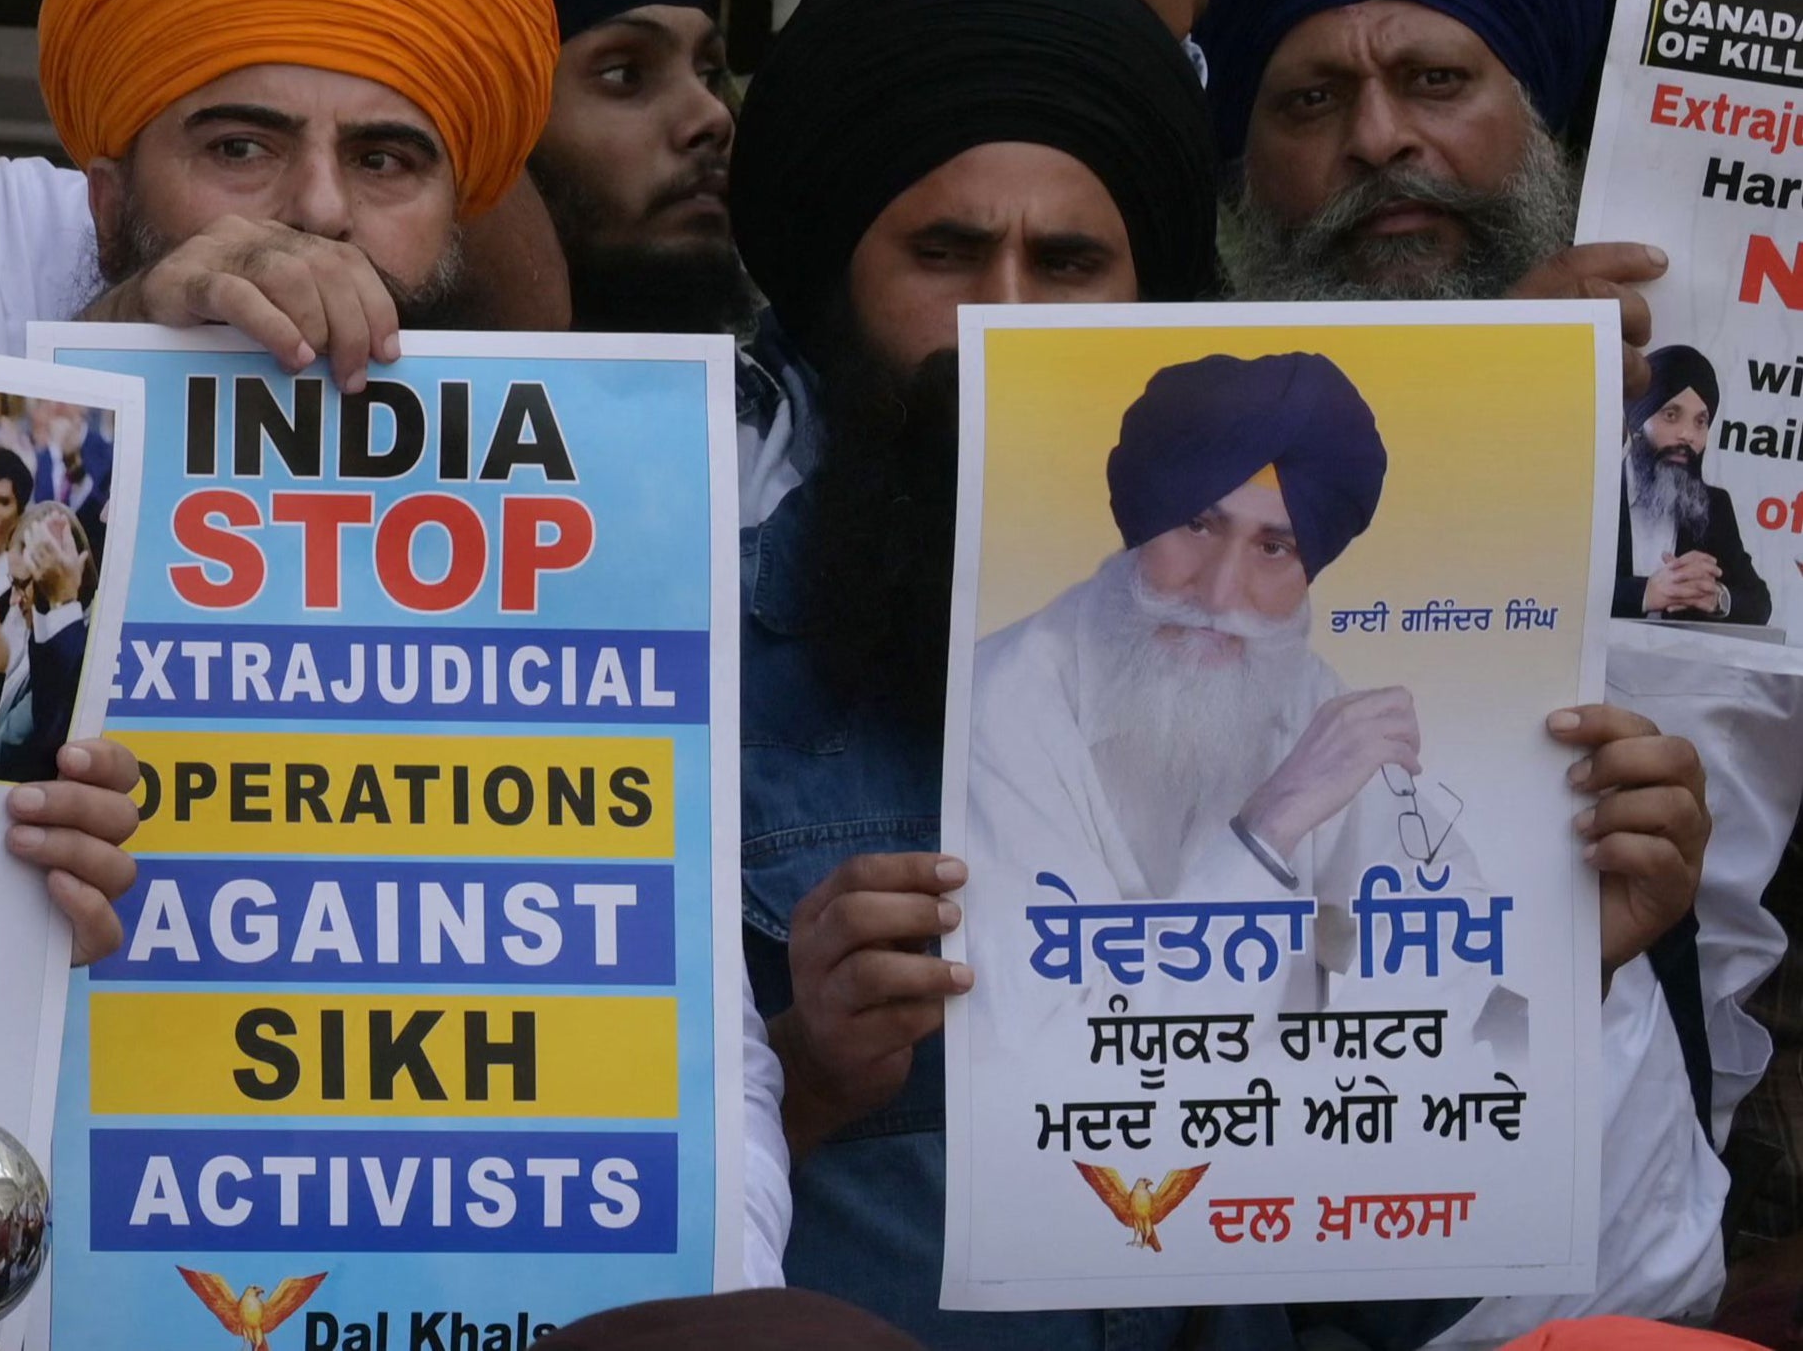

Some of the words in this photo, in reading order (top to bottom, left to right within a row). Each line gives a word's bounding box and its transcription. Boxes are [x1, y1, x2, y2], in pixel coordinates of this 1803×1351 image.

[1657, 31, 1709, 61] OF
[1702, 157, 1803, 209] Har
[185, 376, 578, 483] INDIA
[168, 490, 595, 614] STOP
[1331, 600, 1390, 633] ਭਾਈ
[1402, 599, 1493, 631] ਗਜਿੰਦਰ
[1505, 598, 1558, 631] ਸਿੰਘ
[127, 879, 637, 966] AGAINST
[1026, 871, 1314, 985] ਬੇਵਤਨਾ
[1352, 864, 1513, 978] ਸਿੱਖ
[233, 1007, 536, 1102] SIKH
[1087, 994, 1254, 1090] ਸੰਯੂਕਤ
[1278, 1009, 1448, 1061] ਰਾਸ਼ਟਰ
[1035, 1102, 1156, 1151] ਮਦਦ
[1180, 1078, 1280, 1148] ਲਈ
[1303, 1075, 1398, 1145] ਅੱਗੇ
[1422, 1072, 1527, 1142] ਆਵੇ
[129, 1156, 641, 1229] ACTIVISTS
[1208, 1196, 1294, 1243] ਦਲ
[1317, 1192, 1476, 1243] ਖ਼ਾਲਸਾ
[305, 1311, 388, 1351] Dal
